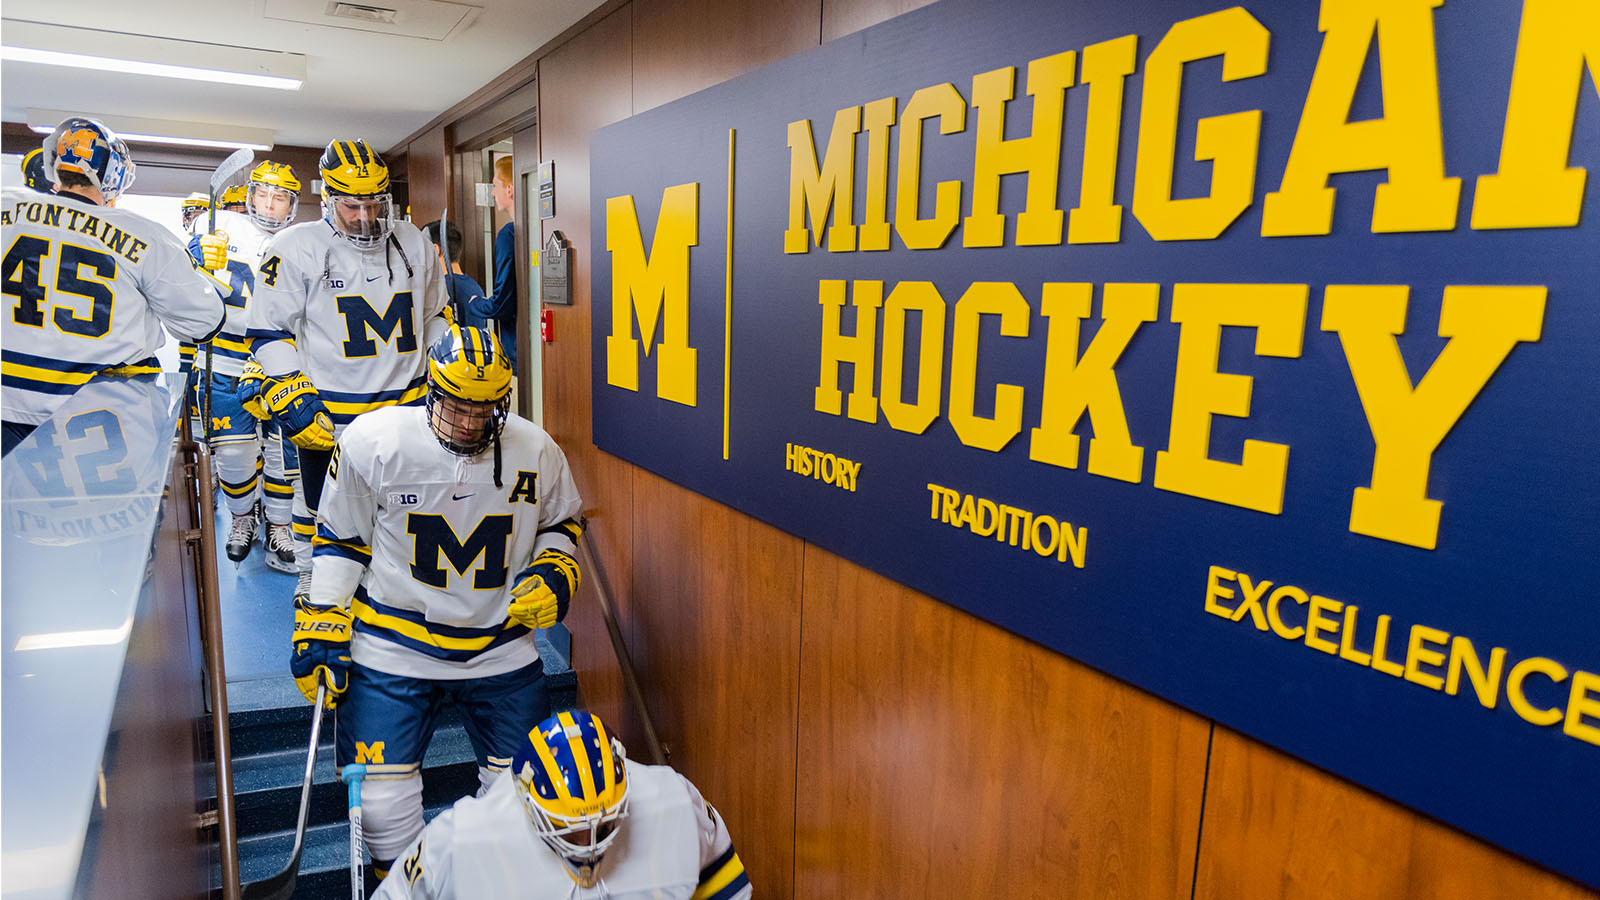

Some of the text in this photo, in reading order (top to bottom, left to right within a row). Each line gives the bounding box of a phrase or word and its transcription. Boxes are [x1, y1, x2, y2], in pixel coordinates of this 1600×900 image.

[57, 129, 99, 161] M
[355, 165, 369, 177] 74
[1, 234, 118, 340] 45
[259, 253, 282, 288] 4
[606, 183, 698, 407] M
[335, 290, 418, 359] M
[477, 366, 485, 378] 5
[212, 416, 232, 431] M
[815, 280, 1548, 550] HOCKEY
[508, 470, 539, 506] A
[406, 511, 514, 591] M
[786, 443, 1600, 745] HISTORY TRADITION EXCELLENCE
[355, 740, 385, 764] M
